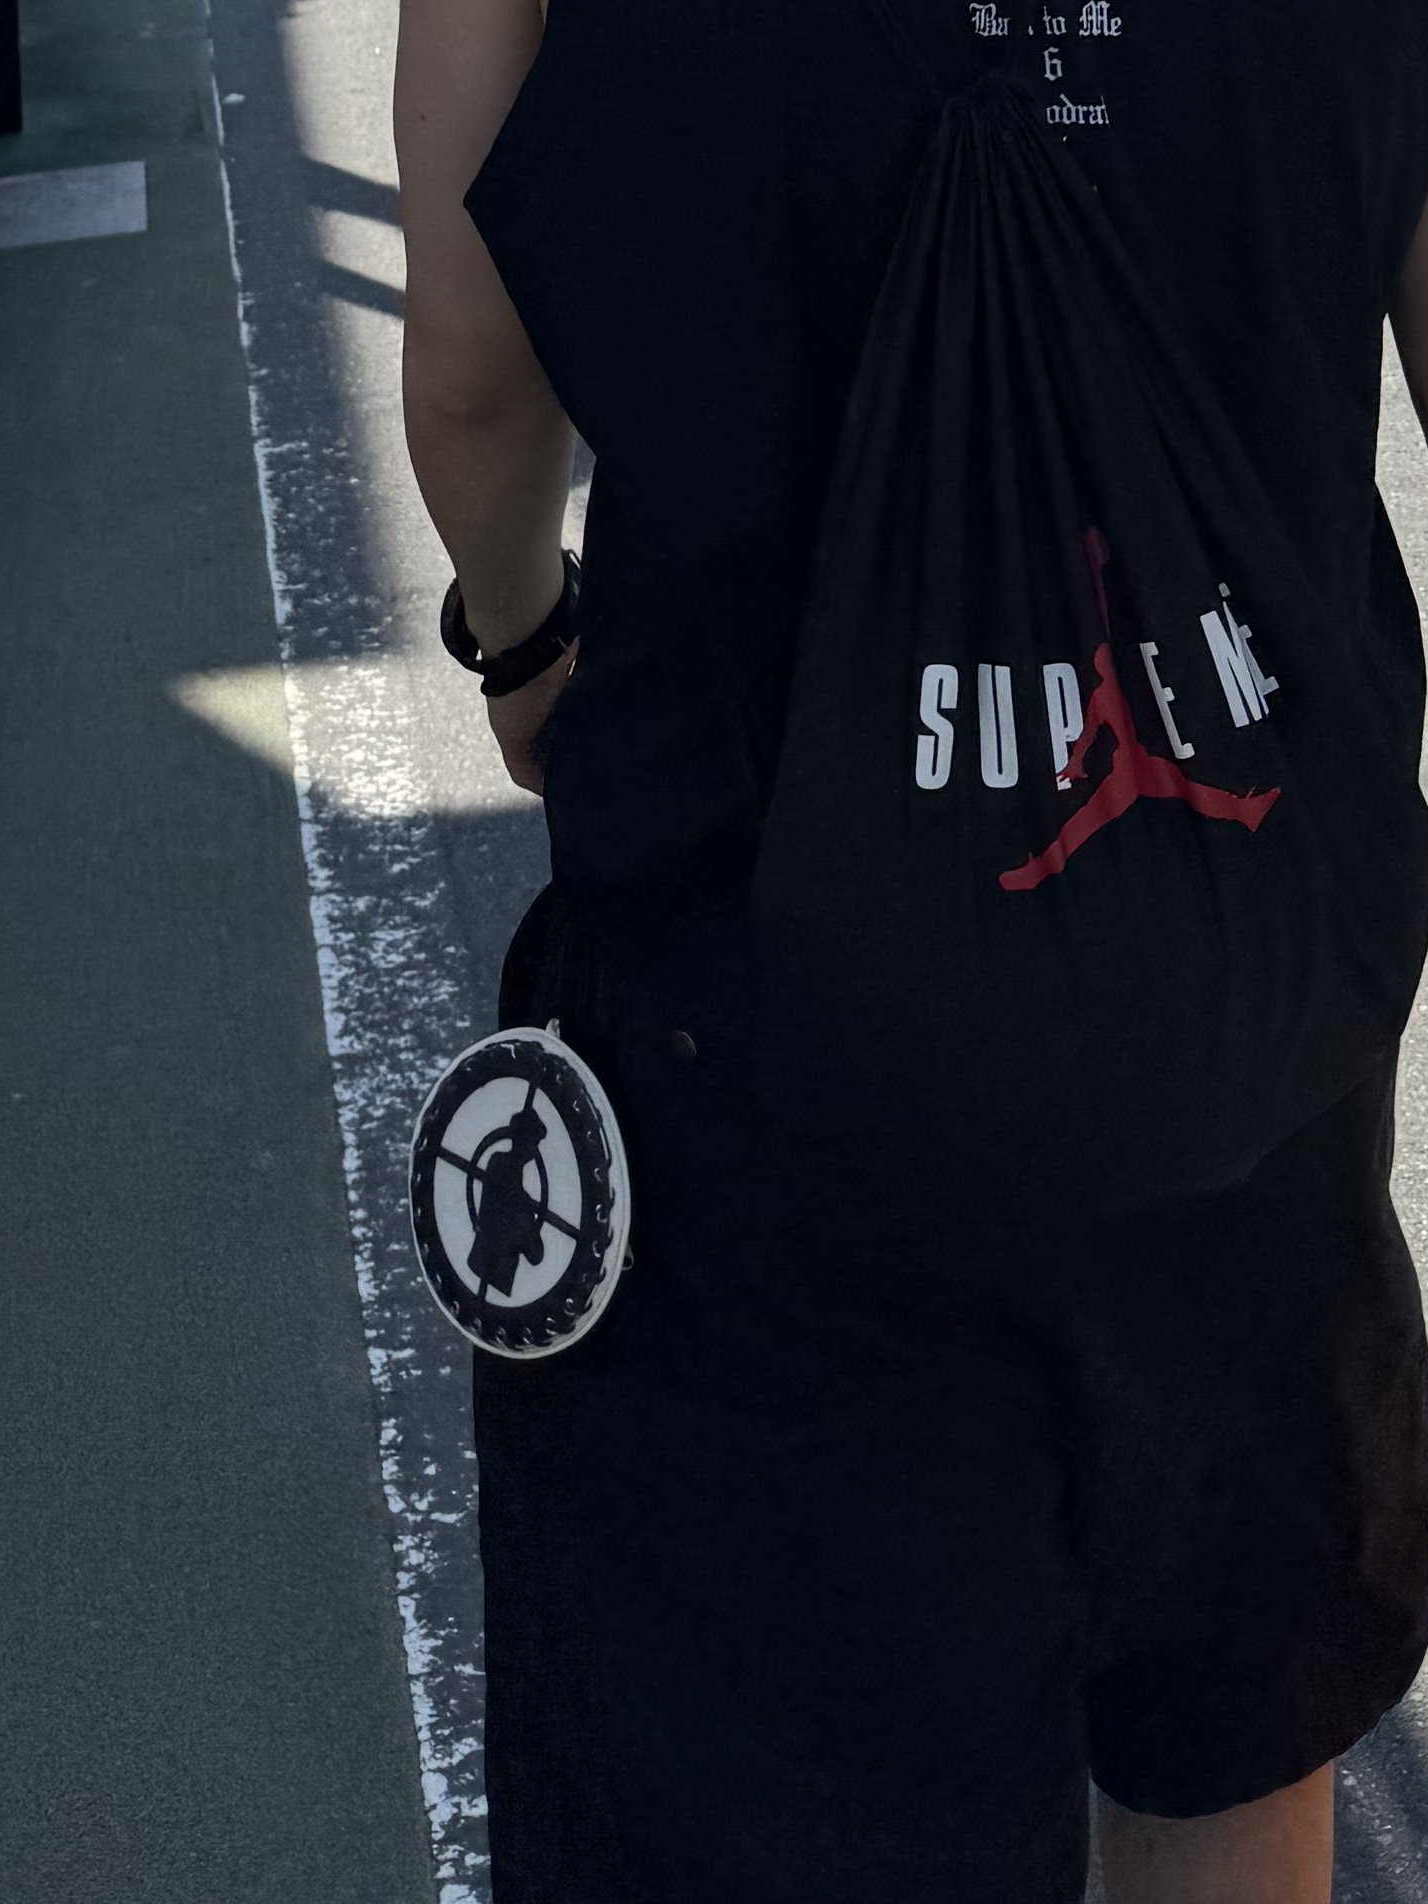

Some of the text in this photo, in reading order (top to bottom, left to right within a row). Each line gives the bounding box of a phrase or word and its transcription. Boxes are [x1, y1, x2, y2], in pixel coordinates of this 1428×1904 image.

[1042, 5, 1068, 36] to
[1079, 0, 1123, 37] Me
[1042, 47, 1063, 82] 6
